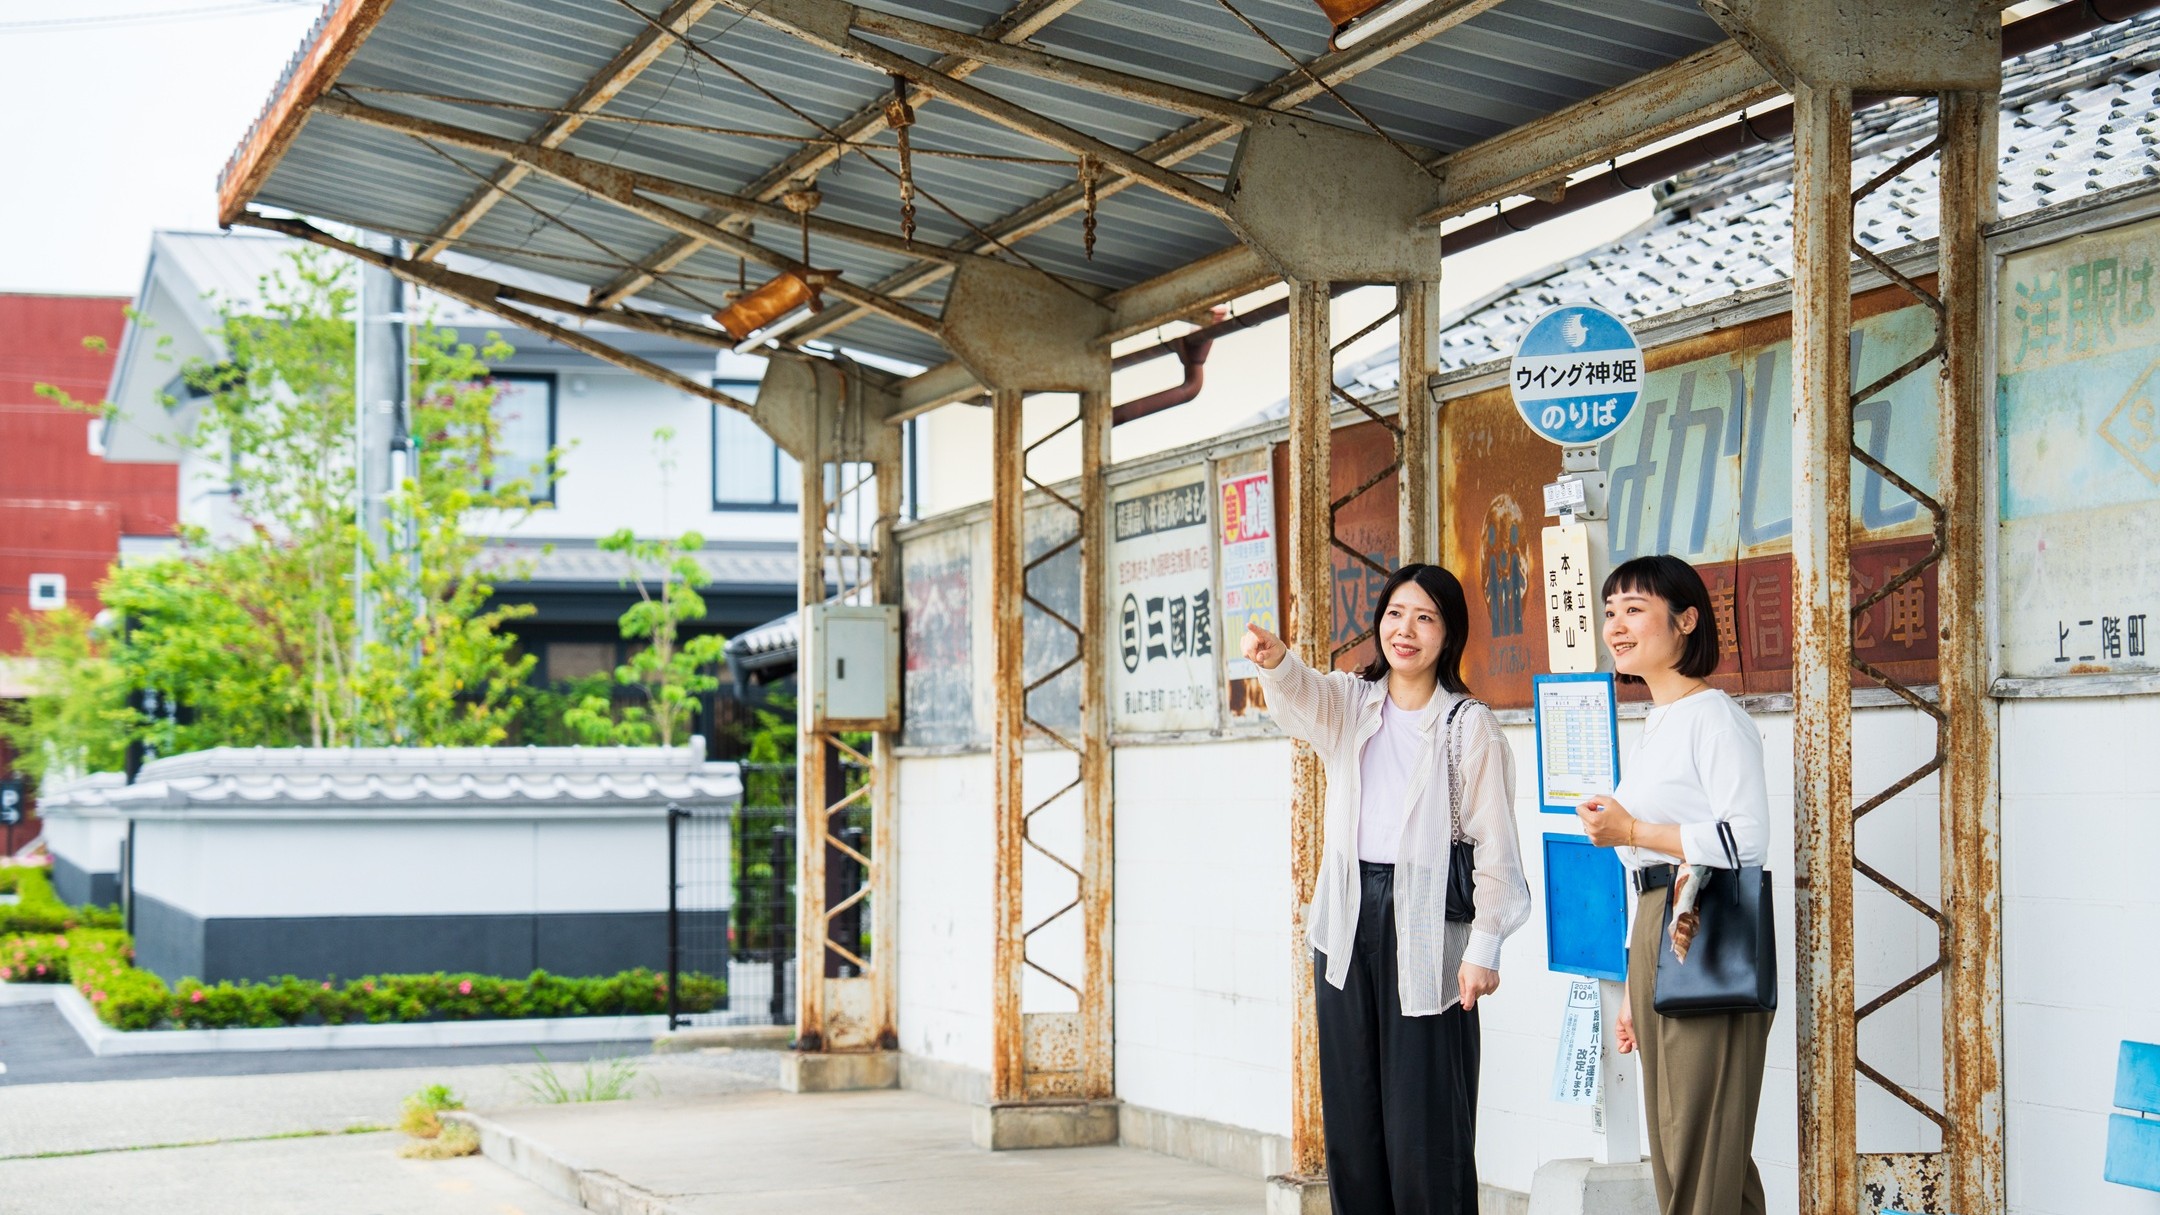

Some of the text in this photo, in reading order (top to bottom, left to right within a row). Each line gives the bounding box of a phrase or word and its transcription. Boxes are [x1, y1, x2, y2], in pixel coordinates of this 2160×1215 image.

[2015, 257, 2155, 366] 洋服は
[1516, 360, 1637, 390] ウイング神姫
[1541, 397, 1618, 429] のりば
[1243, 582, 1272, 609] 0120
[1549, 570, 1561, 633] 京口橋
[1560, 553, 1576, 648] 本篠山
[1577, 568, 1587, 632] 上立町
[2054, 614, 2147, 662] 上二階町
